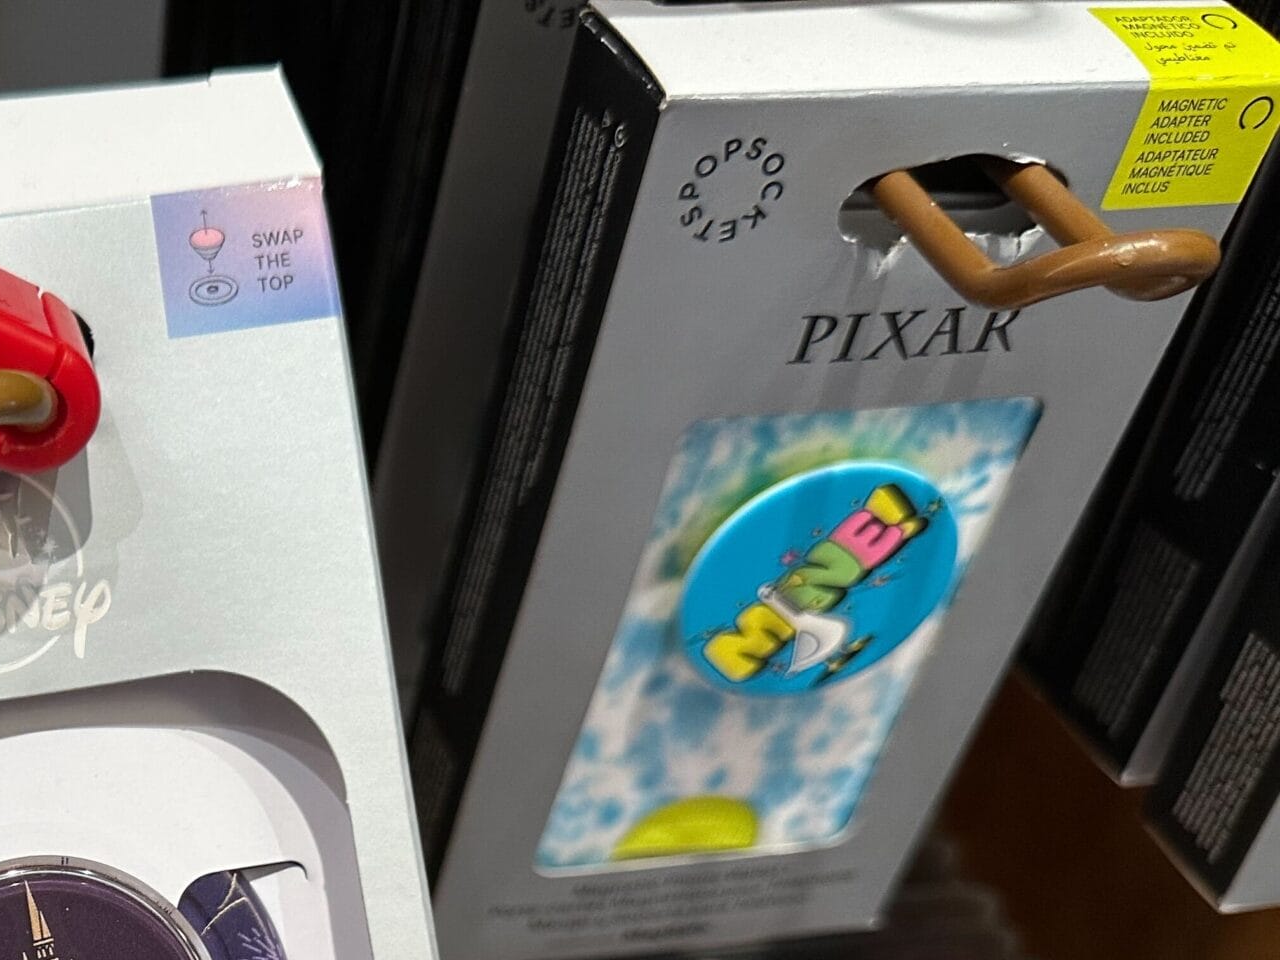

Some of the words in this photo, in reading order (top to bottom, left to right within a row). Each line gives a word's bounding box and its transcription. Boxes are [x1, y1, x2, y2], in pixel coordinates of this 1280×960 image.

[1158, 98, 1228, 113] MAGNETIC
[1150, 115, 1212, 129] ADAPTER
[1143, 130, 1210, 145] INCLUDED
[1135, 148, 1219, 163] ADAPTATEUR
[1128, 163, 1214, 179] MAGNÉTIQUE
[1121, 181, 1170, 195] INCLUS
[251, 229, 303, 248] SWAP
[254, 253, 291, 270] THE
[257, 275, 294, 293] TOP
[785, 307, 1020, 365] PIXAR
